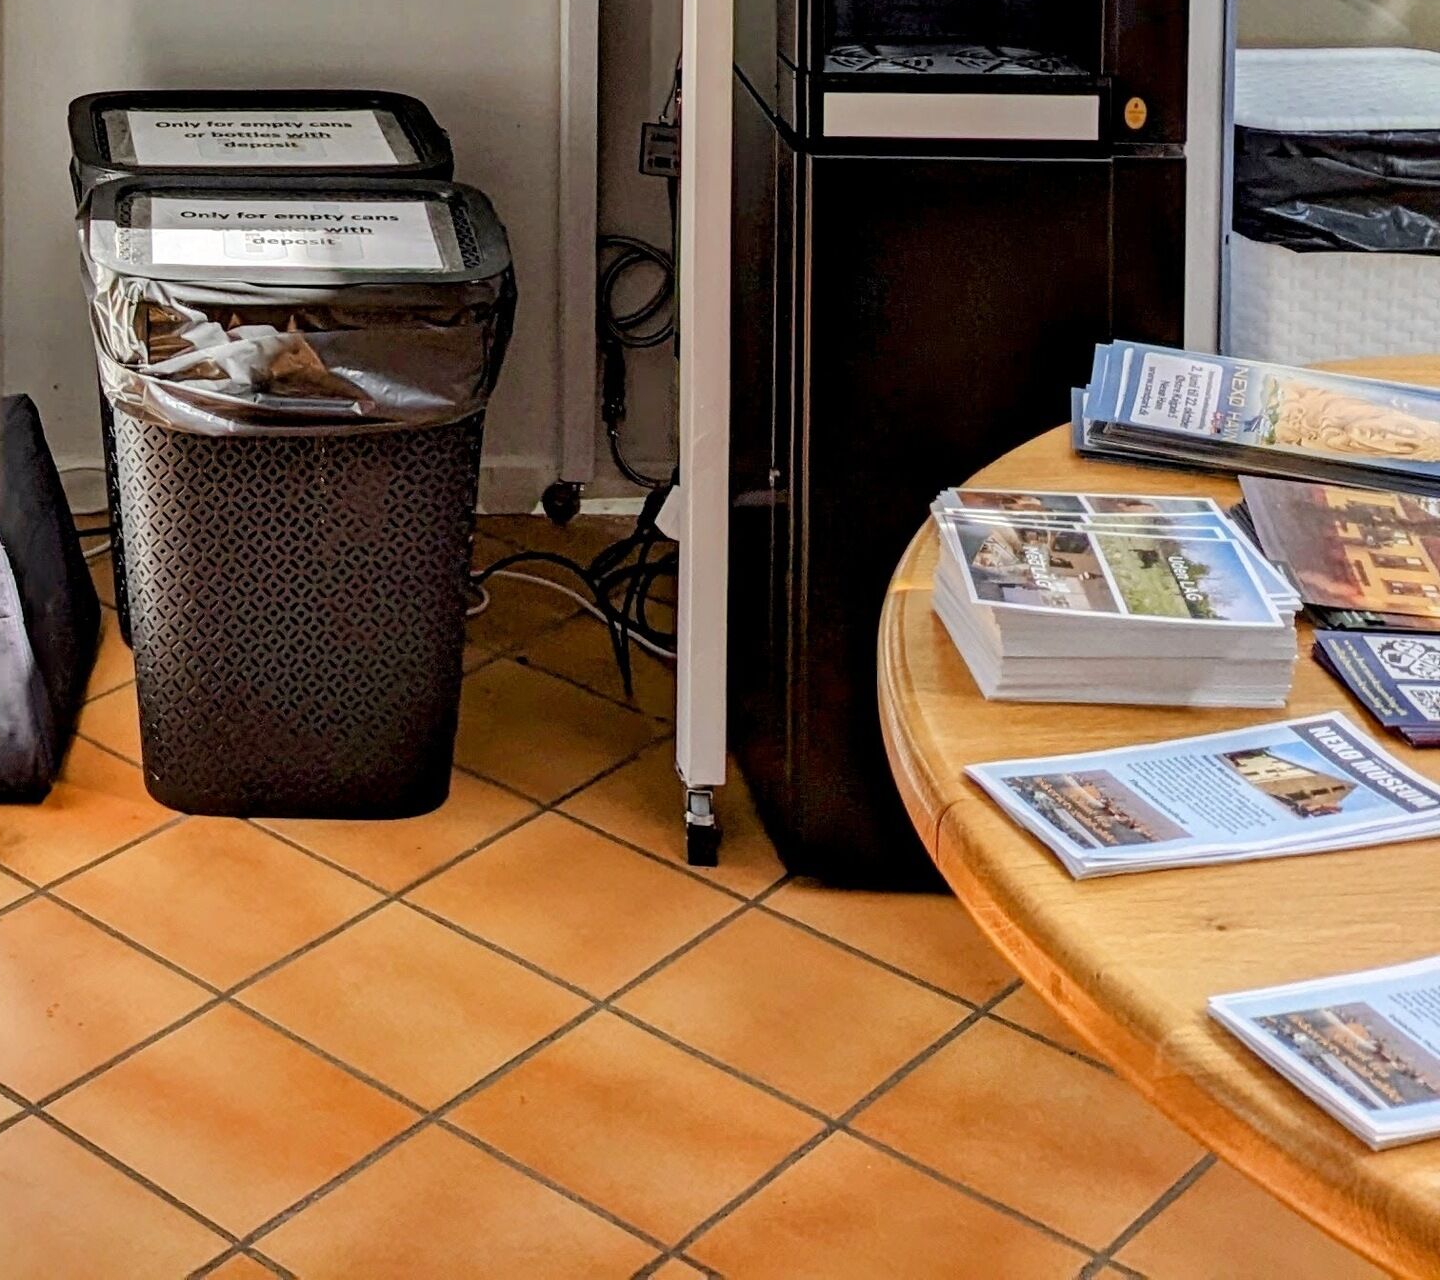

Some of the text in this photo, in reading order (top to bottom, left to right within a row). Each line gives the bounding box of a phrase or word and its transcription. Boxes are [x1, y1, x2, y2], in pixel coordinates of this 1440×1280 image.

[155, 121, 200, 129] Only
[240, 121, 303, 129] empty
[212, 130, 280, 139] bottles
[287, 130, 331, 139] with
[225, 141, 298, 149] deposit
[180, 211, 230, 221] Only
[236, 211, 267, 220] for
[274, 212, 342, 222] empty
[324, 225, 373, 234] with
